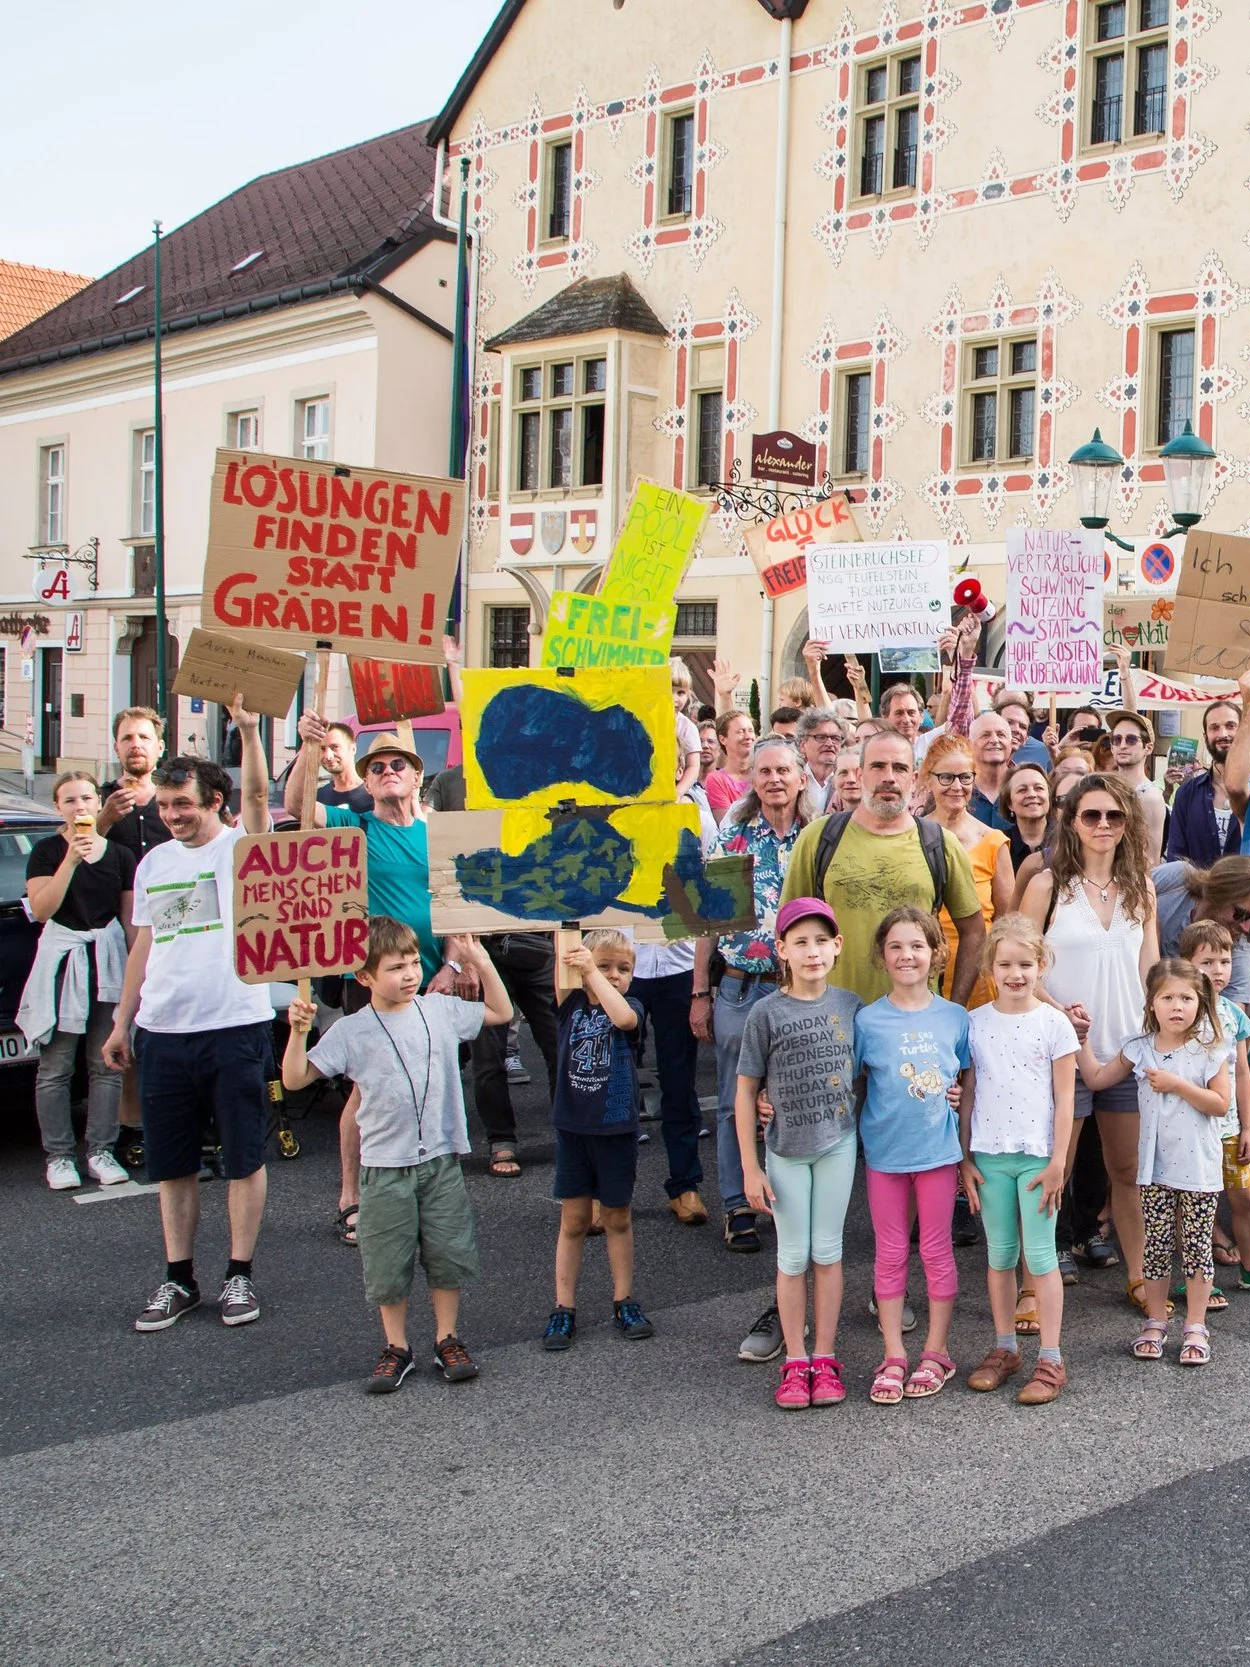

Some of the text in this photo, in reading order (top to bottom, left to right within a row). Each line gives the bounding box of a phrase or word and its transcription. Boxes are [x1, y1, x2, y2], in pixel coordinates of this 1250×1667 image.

[755, 448, 813, 470] alexander
[223, 456, 452, 535] LÖSUNGEN
[655, 489, 686, 515] EIN
[626, 502, 686, 553] POOL
[253, 514, 417, 569] FINDEN
[643, 538, 666, 557] IST
[613, 550, 673, 591] NICHT
[1192, 547, 1233, 575] Ich
[286, 556, 396, 594] STATT
[818, 597, 924, 614] SANFTE NUTZUNG
[1020, 597, 1085, 618] NUTZUNG
[1107, 604, 1126, 616] der
[567, 599, 655, 640] FREI-
[1037, 619, 1071, 642] STATT
[814, 625, 837, 640] MIT
[201, 640, 235, 656] Auch
[1007, 639, 1098, 662] HOHE KOSTEN
[238, 836, 361, 880] AUCH
[243, 870, 361, 908] MENSCHEN
[275, 897, 333, 924] SIND
[236, 918, 369, 977] NATUR
[771, 1015, 829, 1041] MONDAY
[775, 1044, 853, 1068] WEDNESDAY
[776, 1060, 846, 1083] THURSDAY
[778, 1078, 828, 1099] FRIDAY
[781, 1089, 848, 1113] SATURDAY
[785, 1107, 836, 1128] SUNDAY
